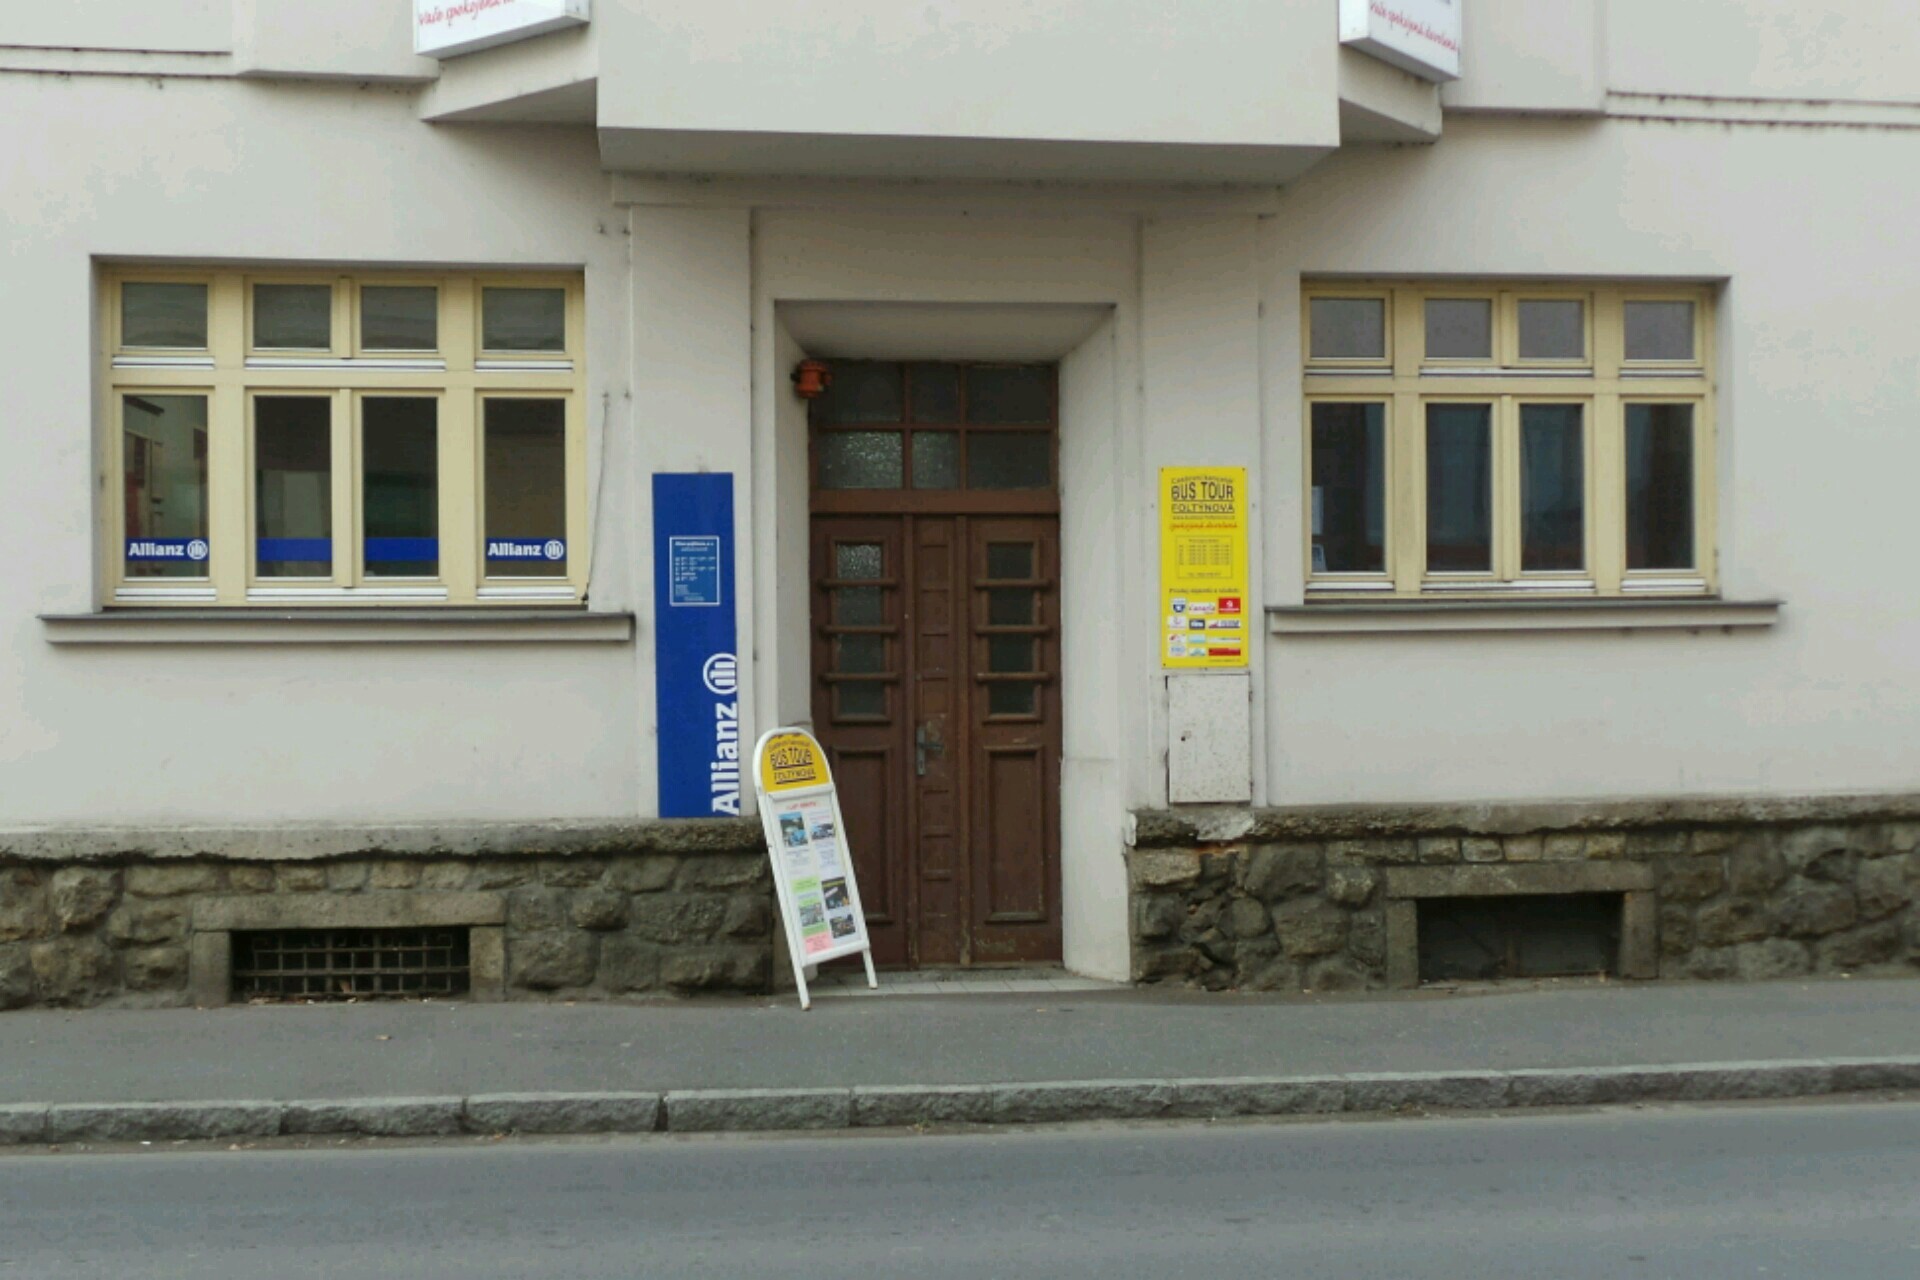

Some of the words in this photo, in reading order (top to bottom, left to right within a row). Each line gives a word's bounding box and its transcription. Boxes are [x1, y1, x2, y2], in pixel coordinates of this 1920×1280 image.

[1171, 482, 1196, 500] BUS
[1200, 481, 1233, 499] TOUR
[128, 542, 184, 556] Allianz
[487, 542, 542, 556] Allianz
[711, 702, 740, 816] Allianz
